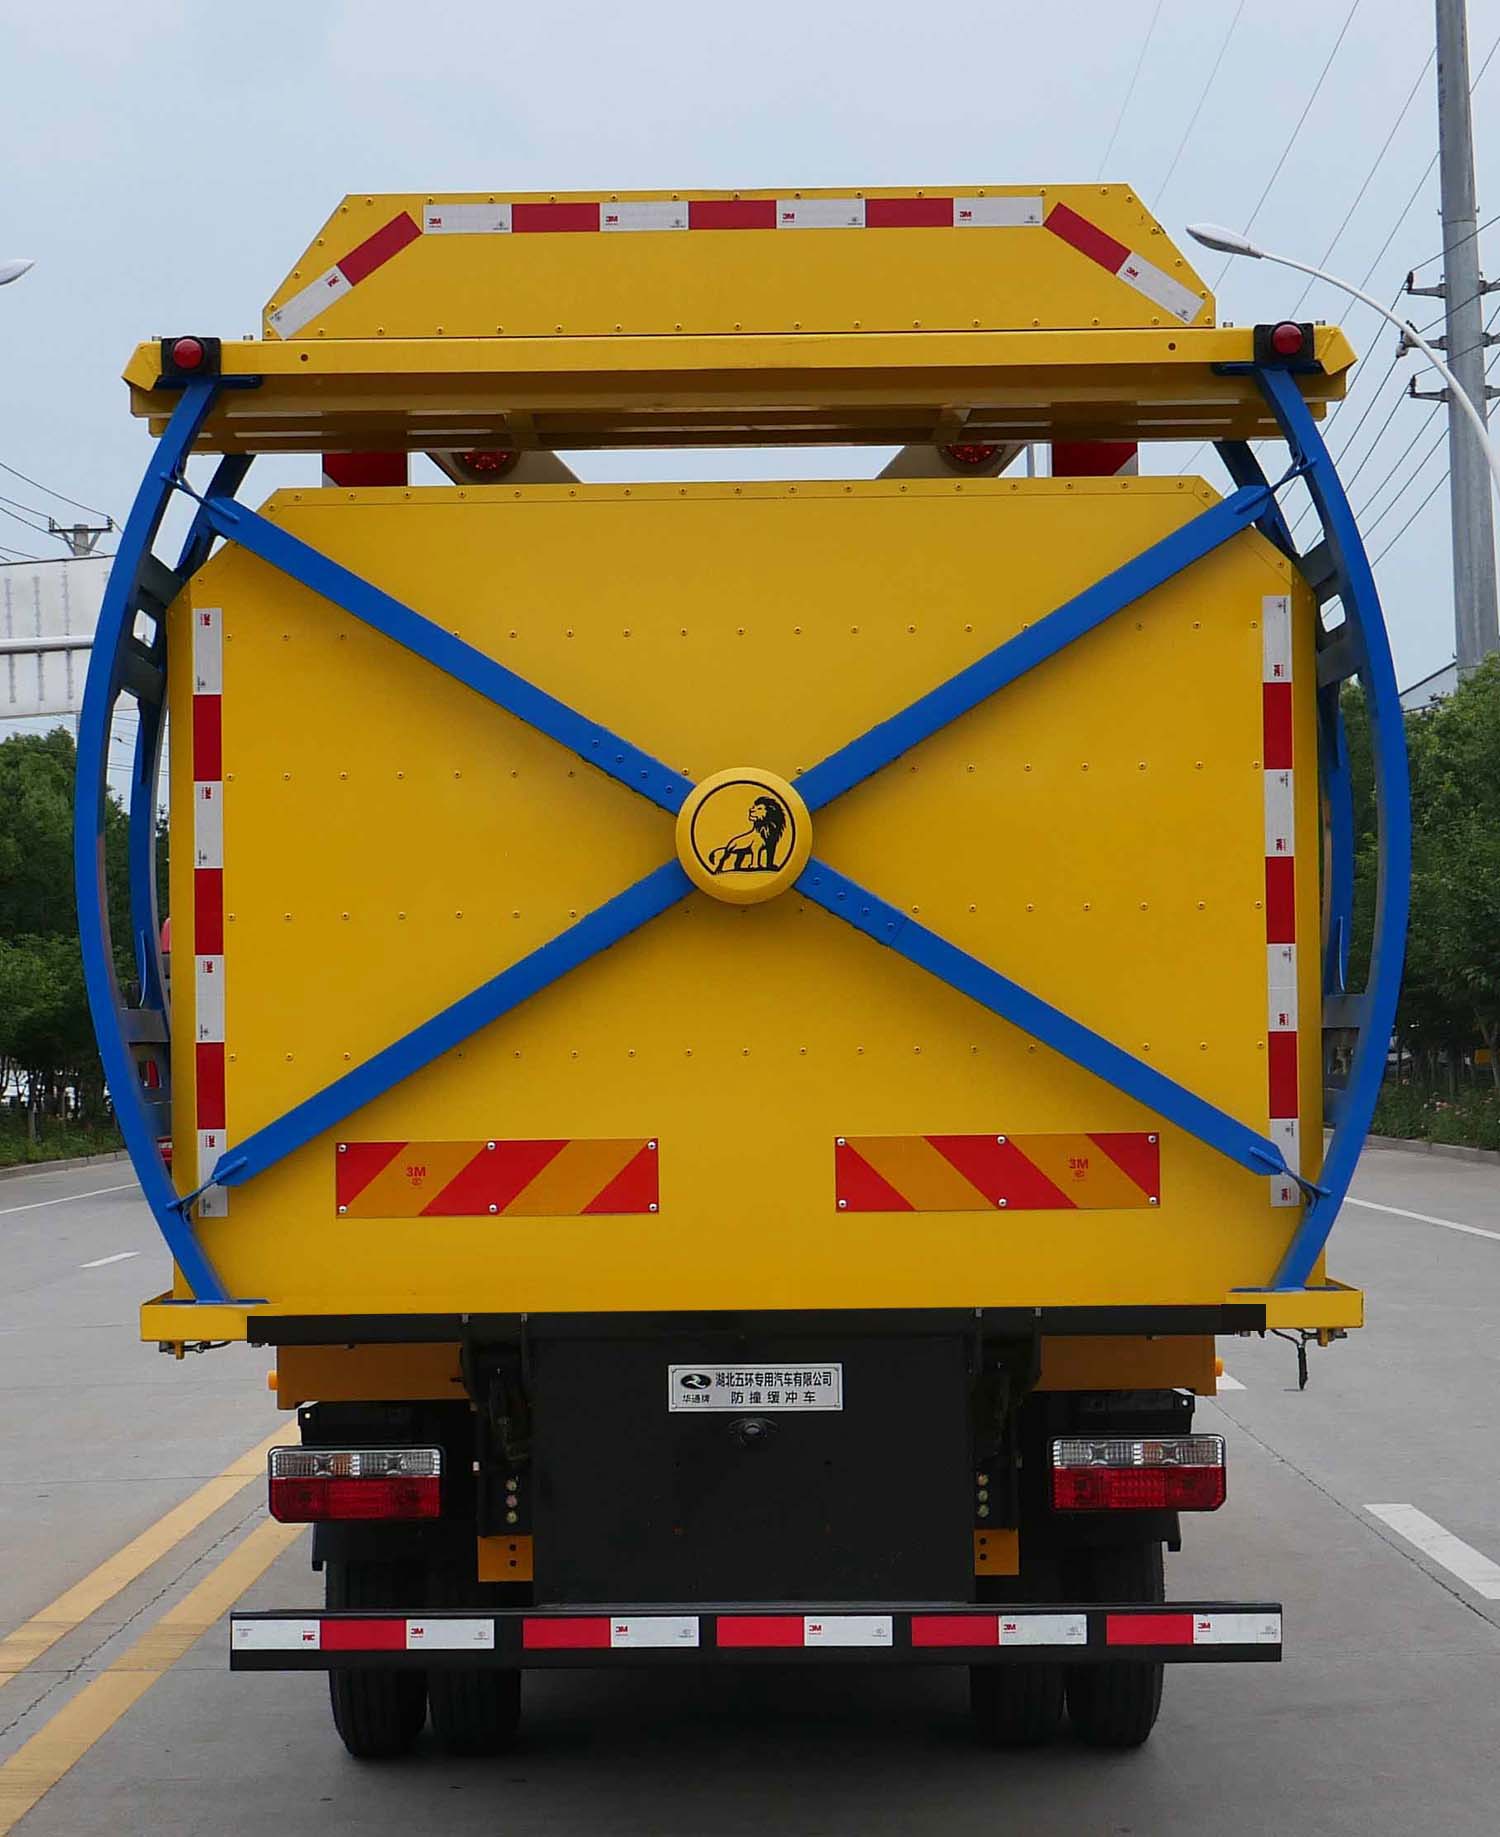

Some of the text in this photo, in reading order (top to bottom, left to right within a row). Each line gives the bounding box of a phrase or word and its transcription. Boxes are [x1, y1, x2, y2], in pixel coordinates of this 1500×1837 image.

[1069, 1159, 1088, 1168] 3M
[406, 1167, 426, 1176] 3M
[716, 1371, 832, 1387] 湖北五环专用汽车有限公司
[730, 1391, 817, 1404] 防撞缓冲车
